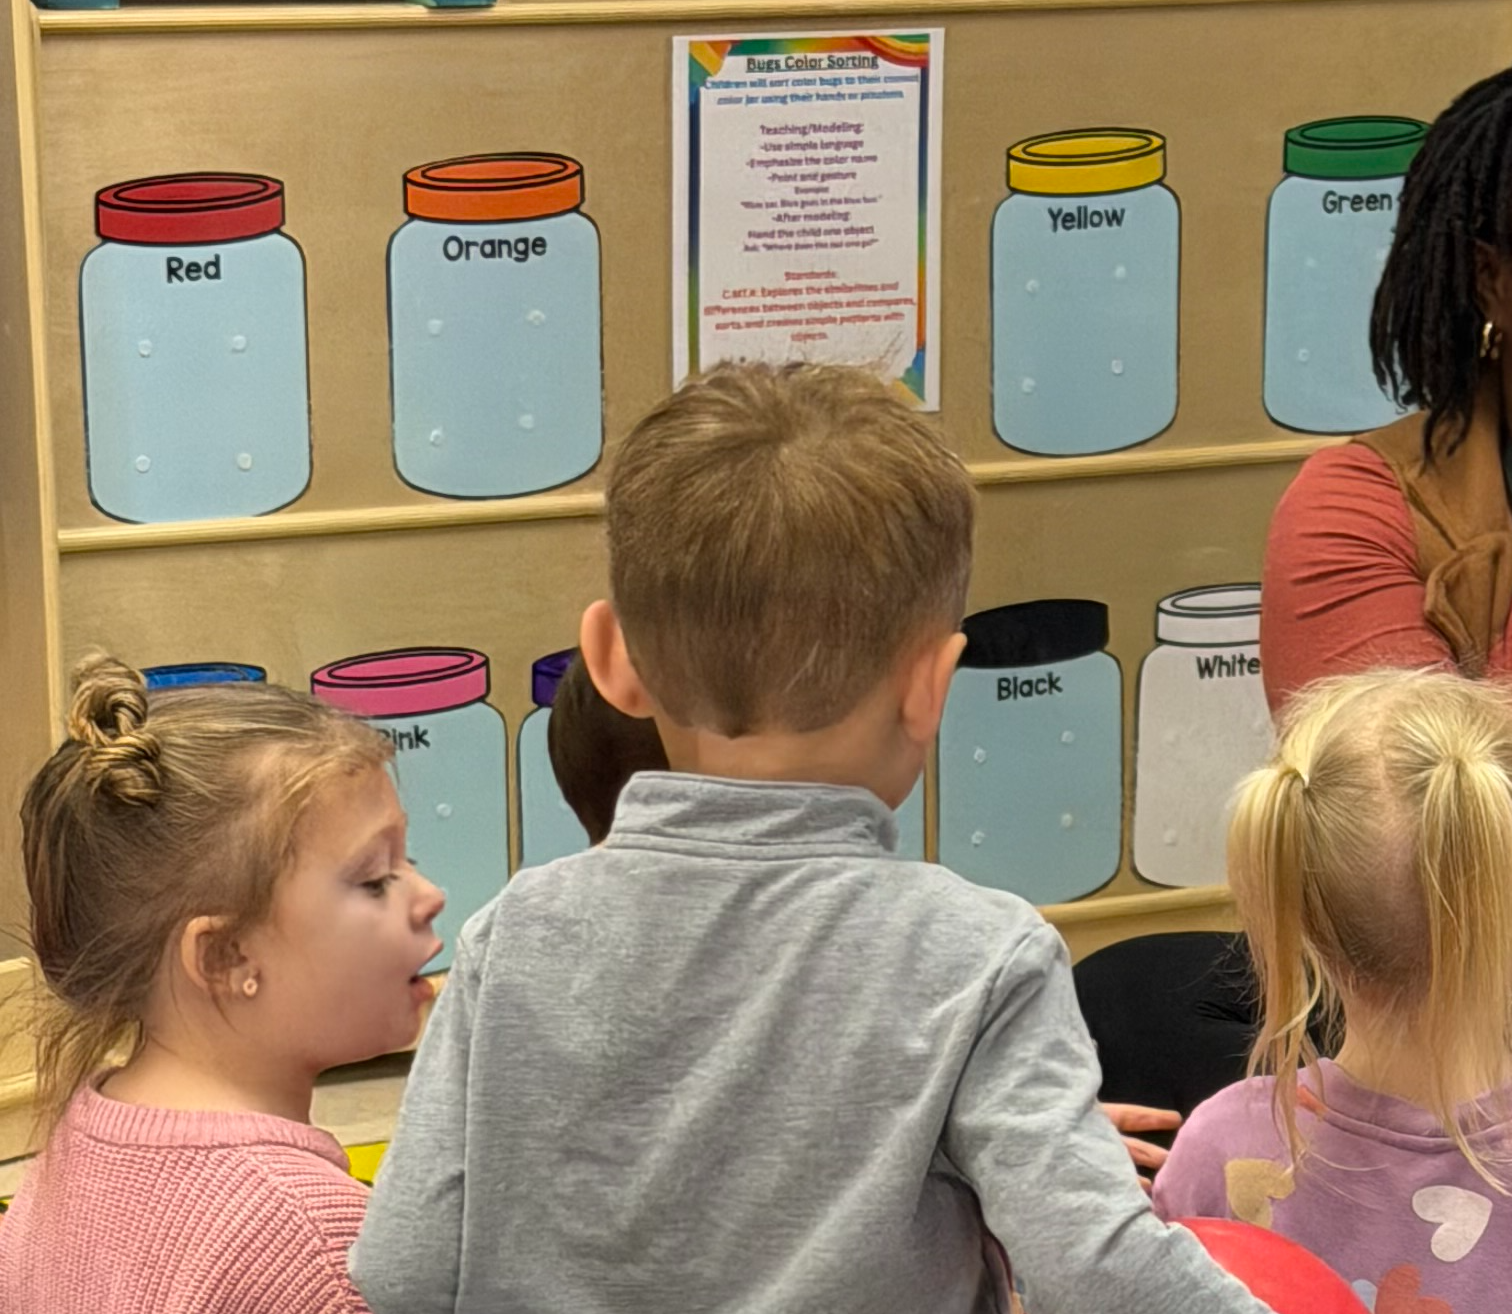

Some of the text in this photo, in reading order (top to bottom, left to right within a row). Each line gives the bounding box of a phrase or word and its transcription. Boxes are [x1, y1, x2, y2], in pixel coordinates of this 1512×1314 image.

[746, 54, 879, 72] Bugs Color Sorting
[704, 80, 748, 90] Children
[749, 78, 767, 88] will
[769, 78, 788, 88] sort
[791, 77, 816, 87] color
[818, 76, 842, 88] bugs
[844, 76, 855, 85] to
[857, 75, 880, 85] their
[745, 94, 758, 107] jar
[761, 94, 788, 105] using
[789, 92, 814, 103] their
[815, 91, 845, 101] hands
[847, 92, 858, 100] or
[760, 122, 864, 137] Teaching/Modeling:
[760, 139, 864, 152] -Use simple language
[745, 155, 878, 169] -Emphasize the color name
[767, 171, 856, 183] -Point and gesture
[1322, 190, 1393, 214] Green
[771, 211, 802, 222] -After
[1047, 205, 1125, 233] Yellow
[747, 225, 875, 239] Hand the child one object
[442, 235, 547, 263] Orange
[166, 254, 222, 284] Red
[760, 286, 803, 299] Explores
[805, 286, 822, 295] the
[824, 282, 878, 294] similarities
[880, 281, 899, 291] and
[704, 304, 760, 316] differences
[762, 303, 806, 313] between
[807, 301, 844, 312] objects
[845, 299, 865, 309] and
[744, 319, 764, 329] and
[766, 318, 803, 328] creates
[805, 316, 838, 326] simple
[840, 314, 882, 326] patterns
[884, 312, 905, 321] with
[1196, 653, 1261, 680] White
[997, 672, 1063, 701] Black
